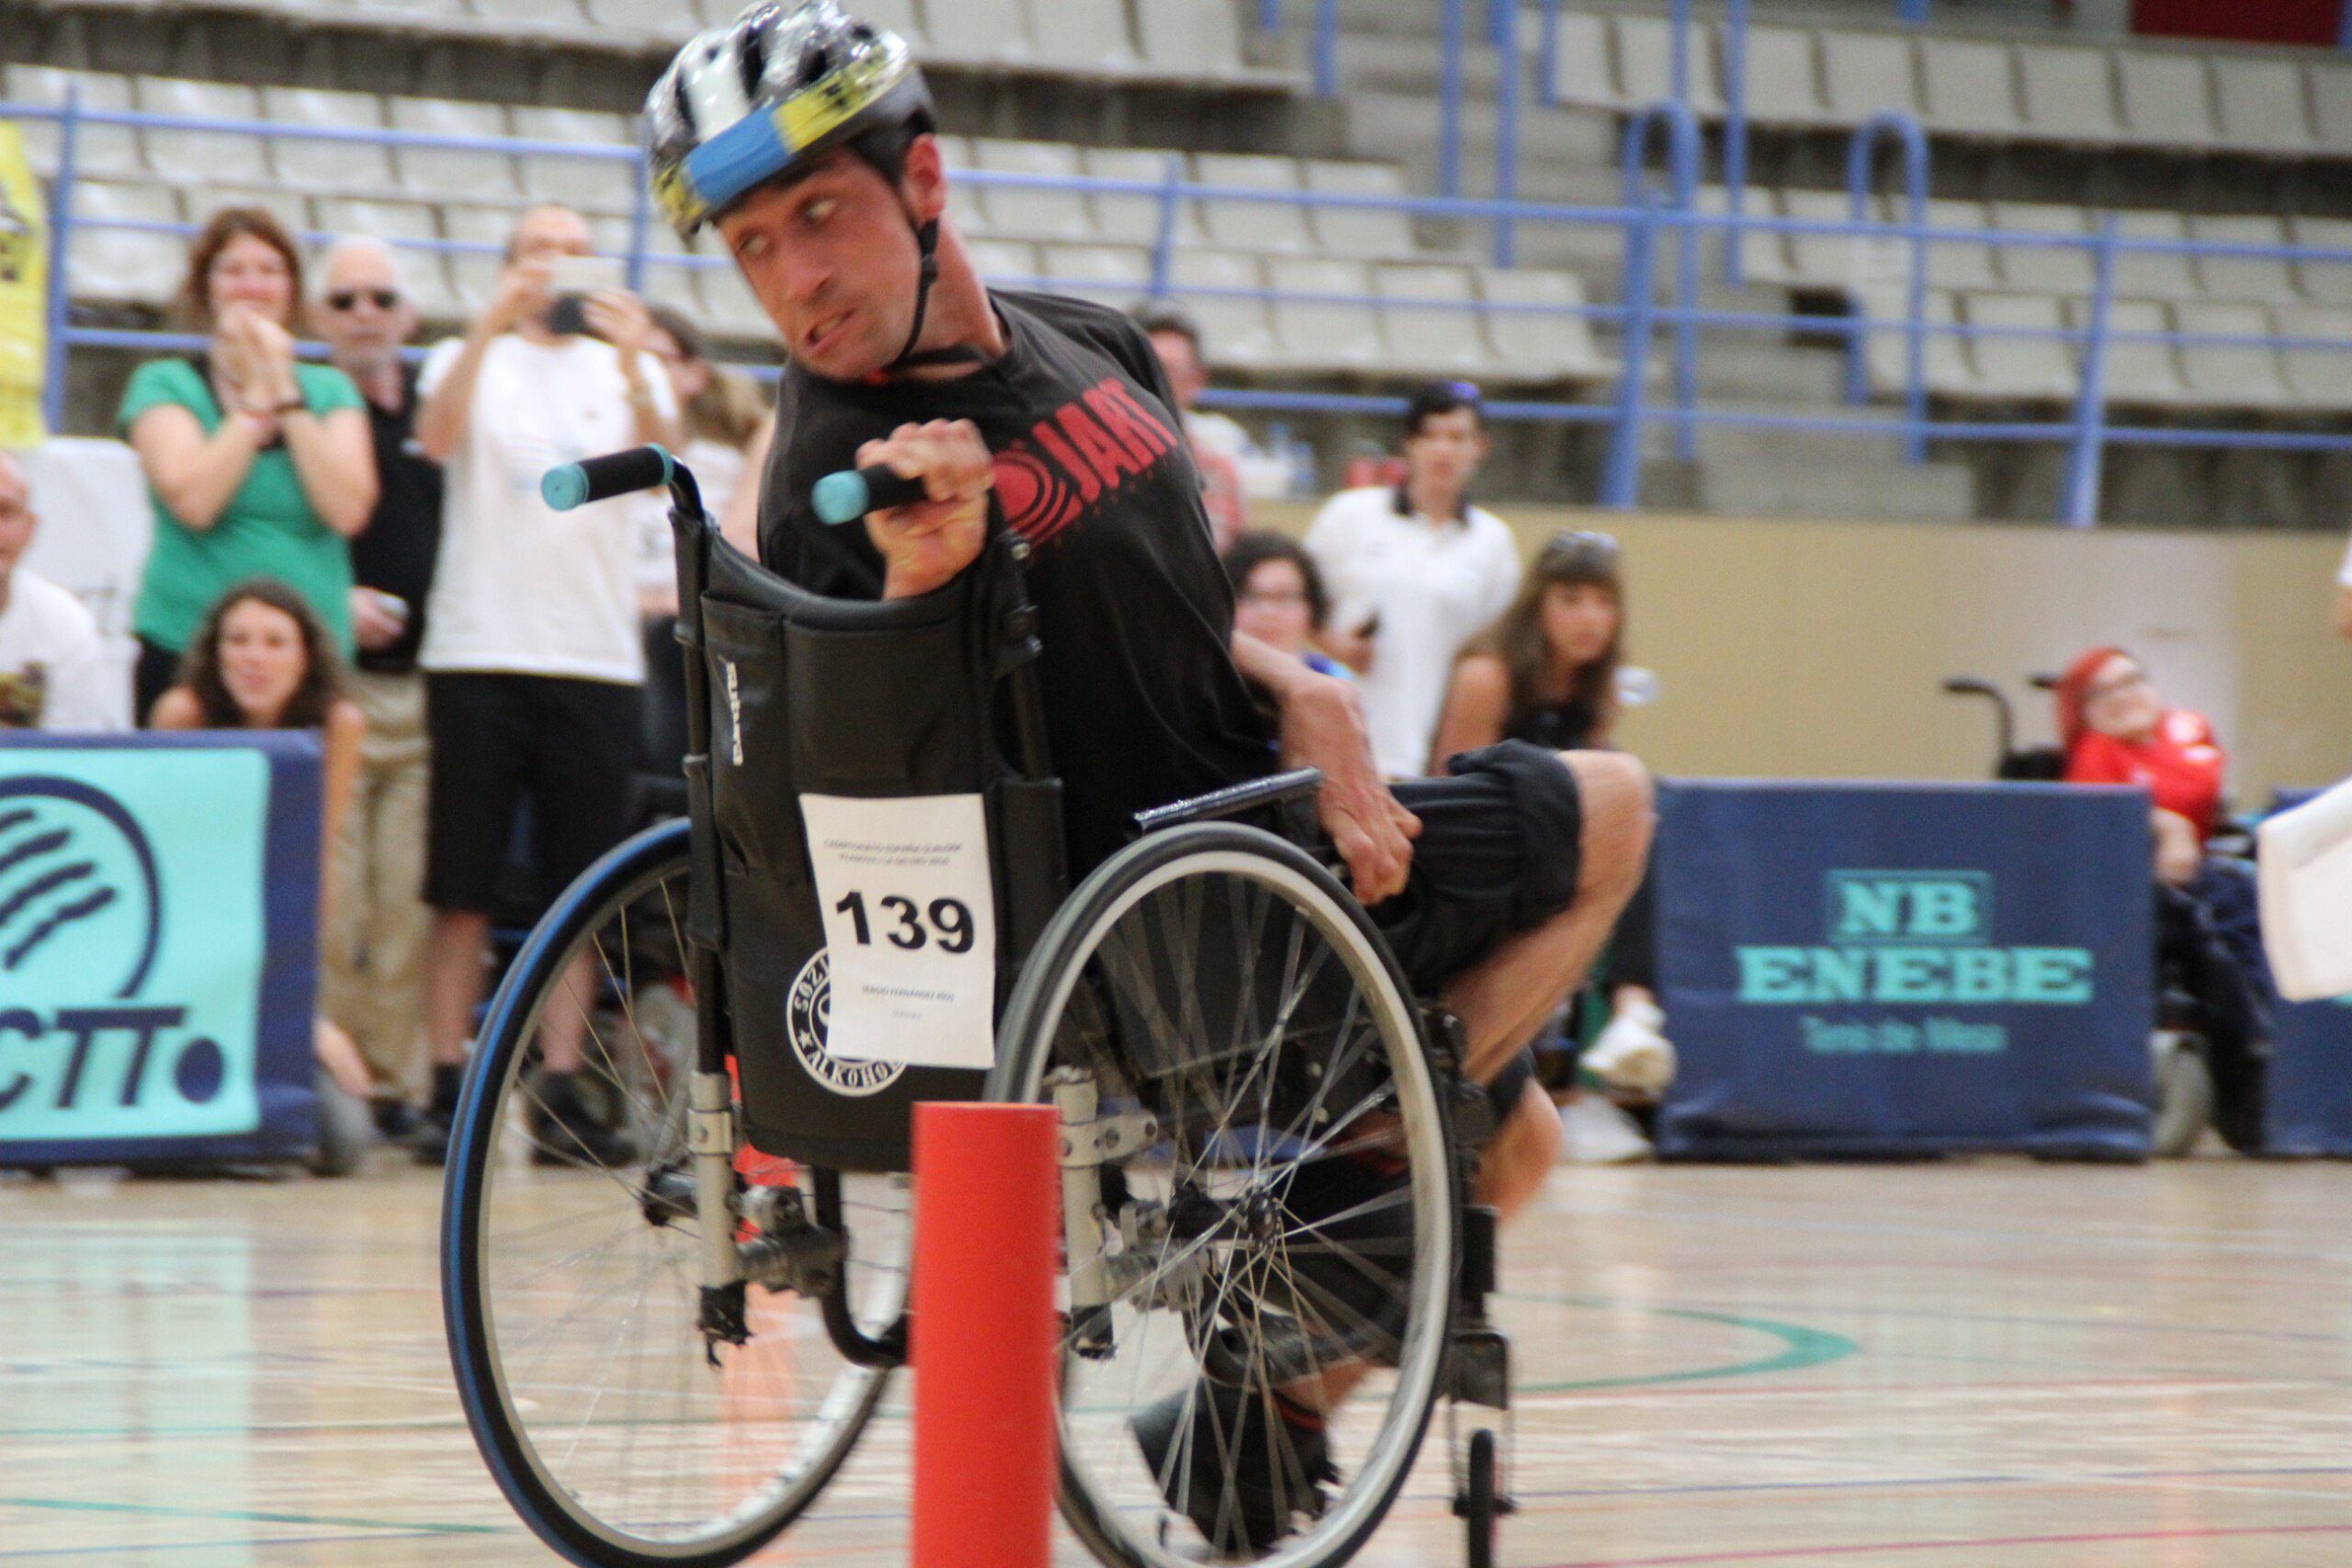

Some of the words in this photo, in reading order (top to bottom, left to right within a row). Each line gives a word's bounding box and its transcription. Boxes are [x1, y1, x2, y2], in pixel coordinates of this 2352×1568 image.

[835, 890, 975, 953] 139
[1838, 881, 1980, 936] NB
[1737, 945, 2096, 1004] ENEBE
